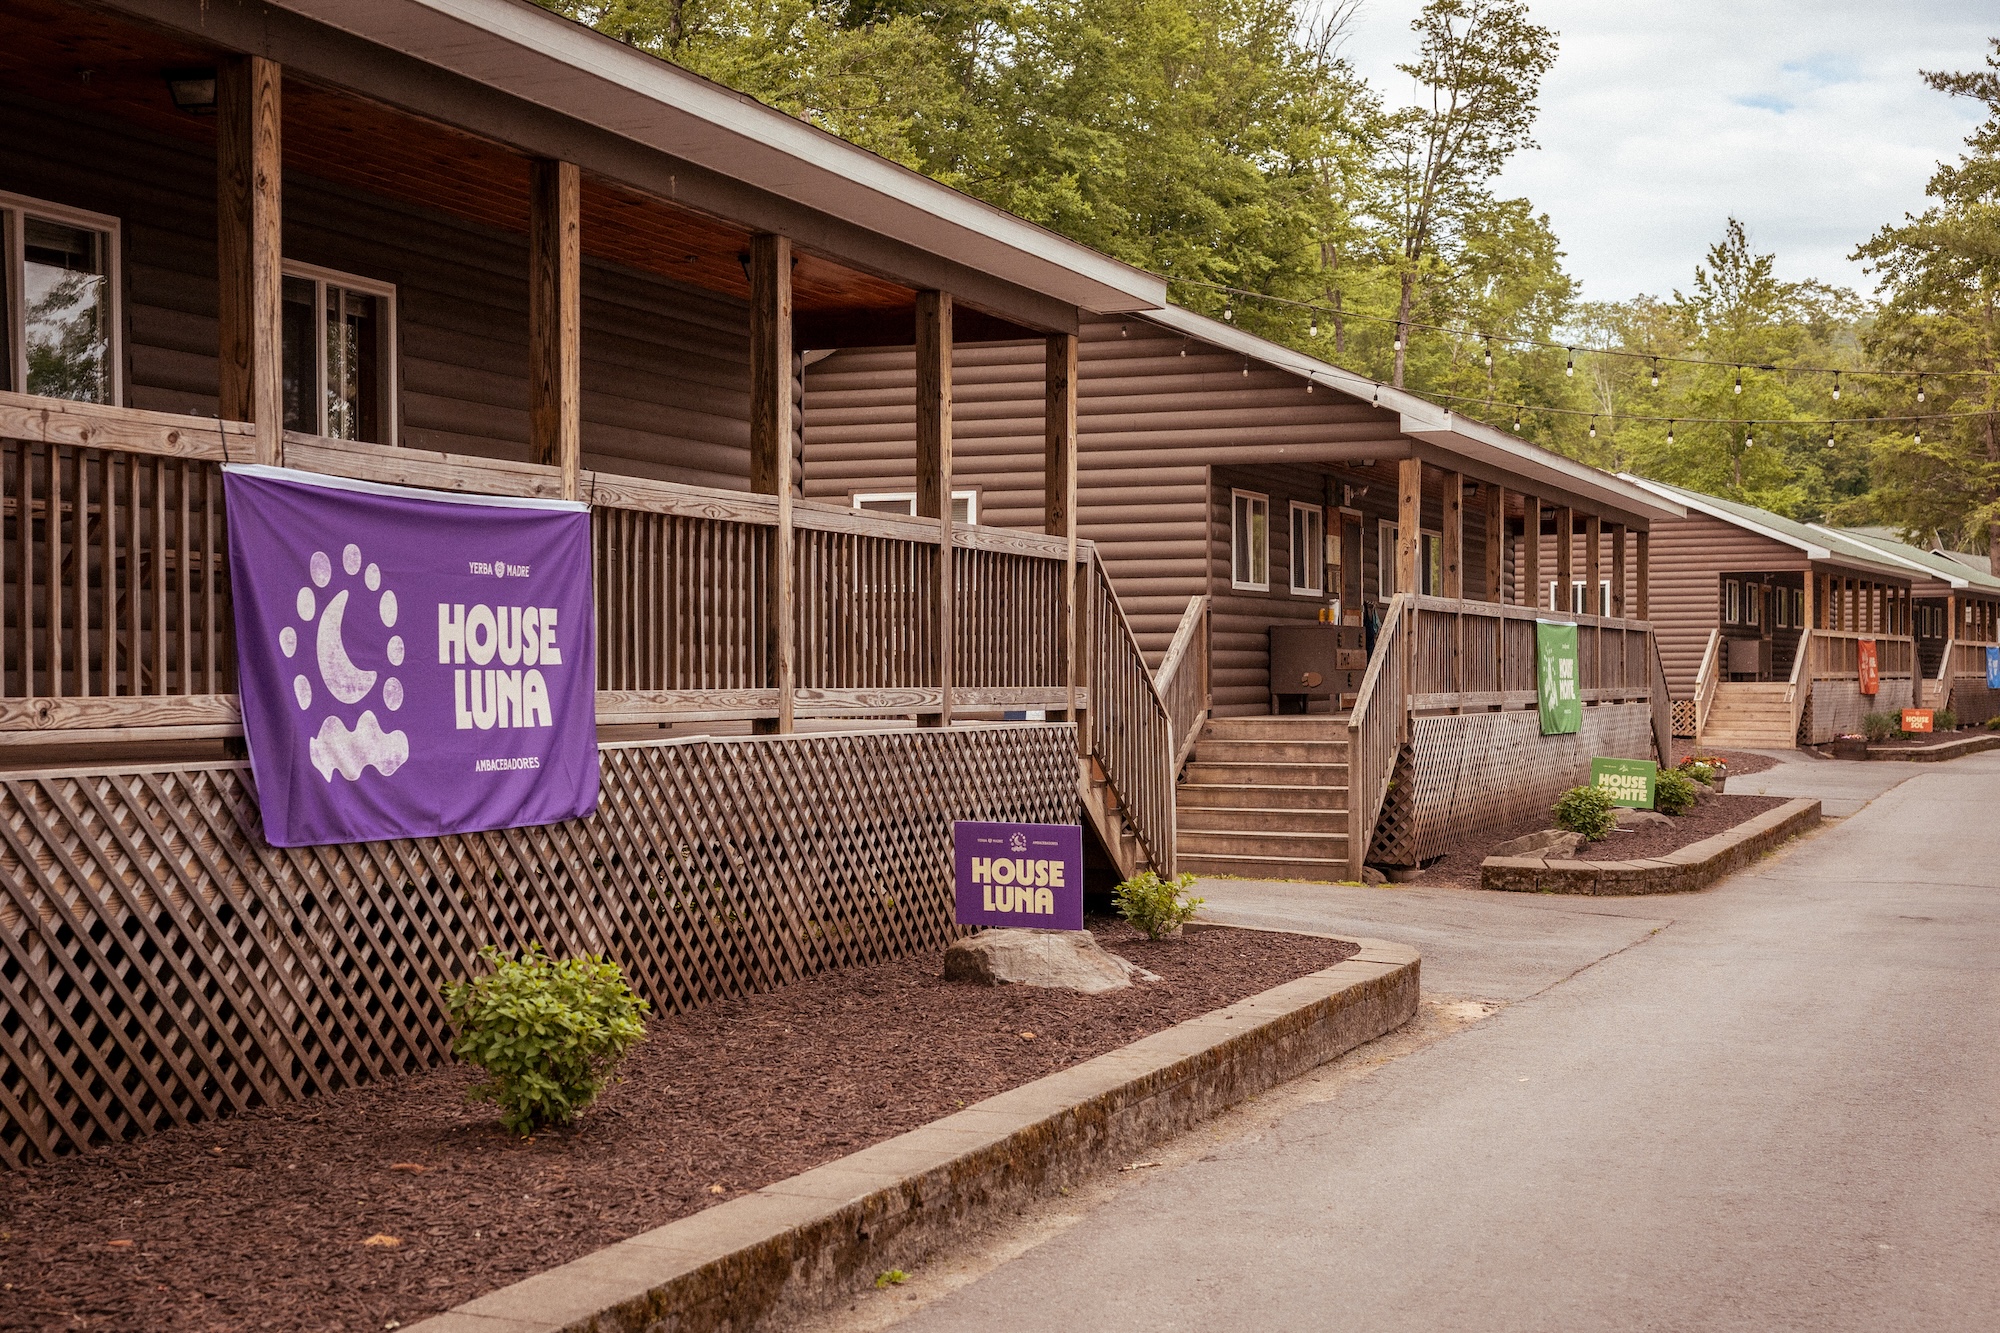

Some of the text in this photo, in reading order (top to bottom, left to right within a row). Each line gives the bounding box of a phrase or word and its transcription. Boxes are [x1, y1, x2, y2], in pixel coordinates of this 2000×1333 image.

[468, 561, 530, 578] YERBA MADRE
[438, 603, 562, 666] HOUSE
[455, 669, 553, 730] LUNA
[475, 756, 540, 772] AMBACEBADORES
[1598, 773, 1648, 789] HOUSE
[971, 857, 1065, 887] HOUSE
[983, 885, 1054, 915] LUNA
